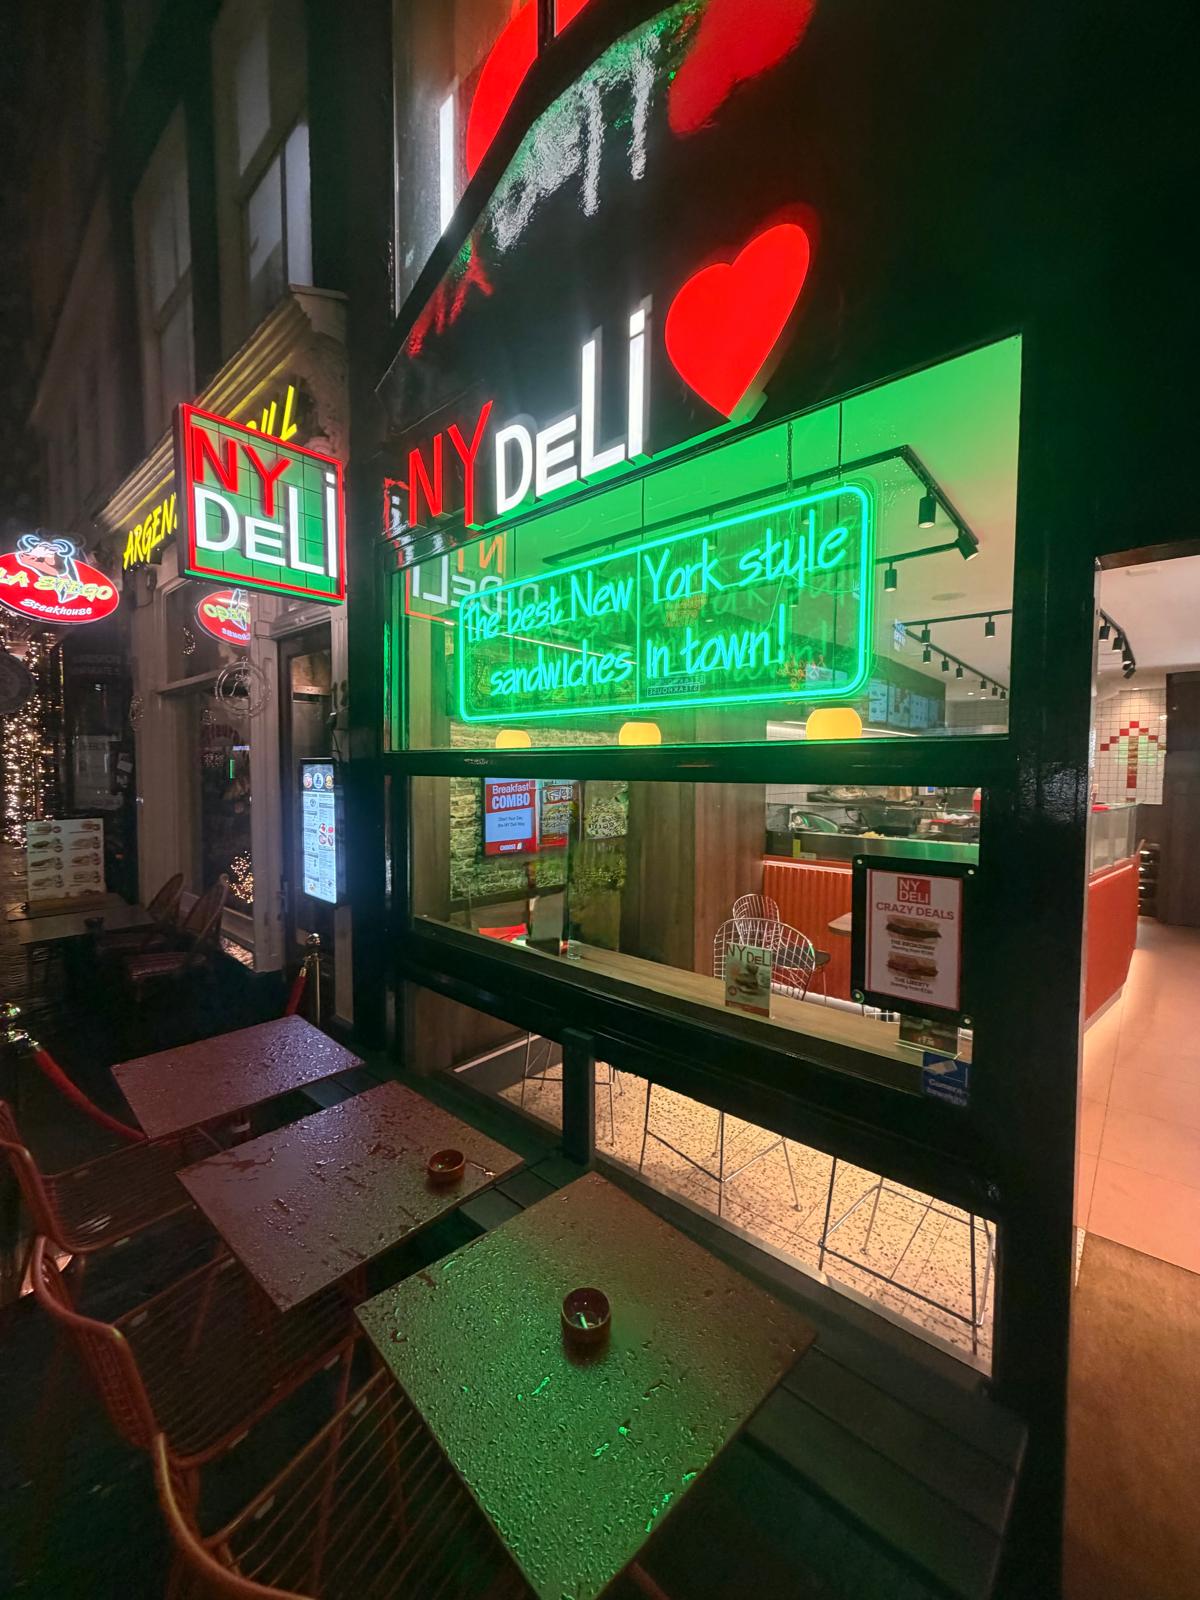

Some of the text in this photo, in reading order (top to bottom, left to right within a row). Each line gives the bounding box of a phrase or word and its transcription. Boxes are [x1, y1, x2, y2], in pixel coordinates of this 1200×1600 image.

[191, 426, 292, 517] NY
[123, 492, 178, 570] ARGEN
[464, 601, 499, 643] The
[508, 585, 565, 634] best
[571, 570, 634, 623] New
[644, 538, 728, 604] York
[739, 509, 849, 588] style
[490, 639, 635, 696] sandwiches
[681, 604, 786, 671] town!
[492, 783, 530, 795] Breakfast
[492, 793, 530, 810] COMBO
[899, 879, 921, 893] NY
[899, 890, 929, 905] DELI
[876, 902, 954, 921] CRAZY DEALS
[727, 943, 747, 961] NY
